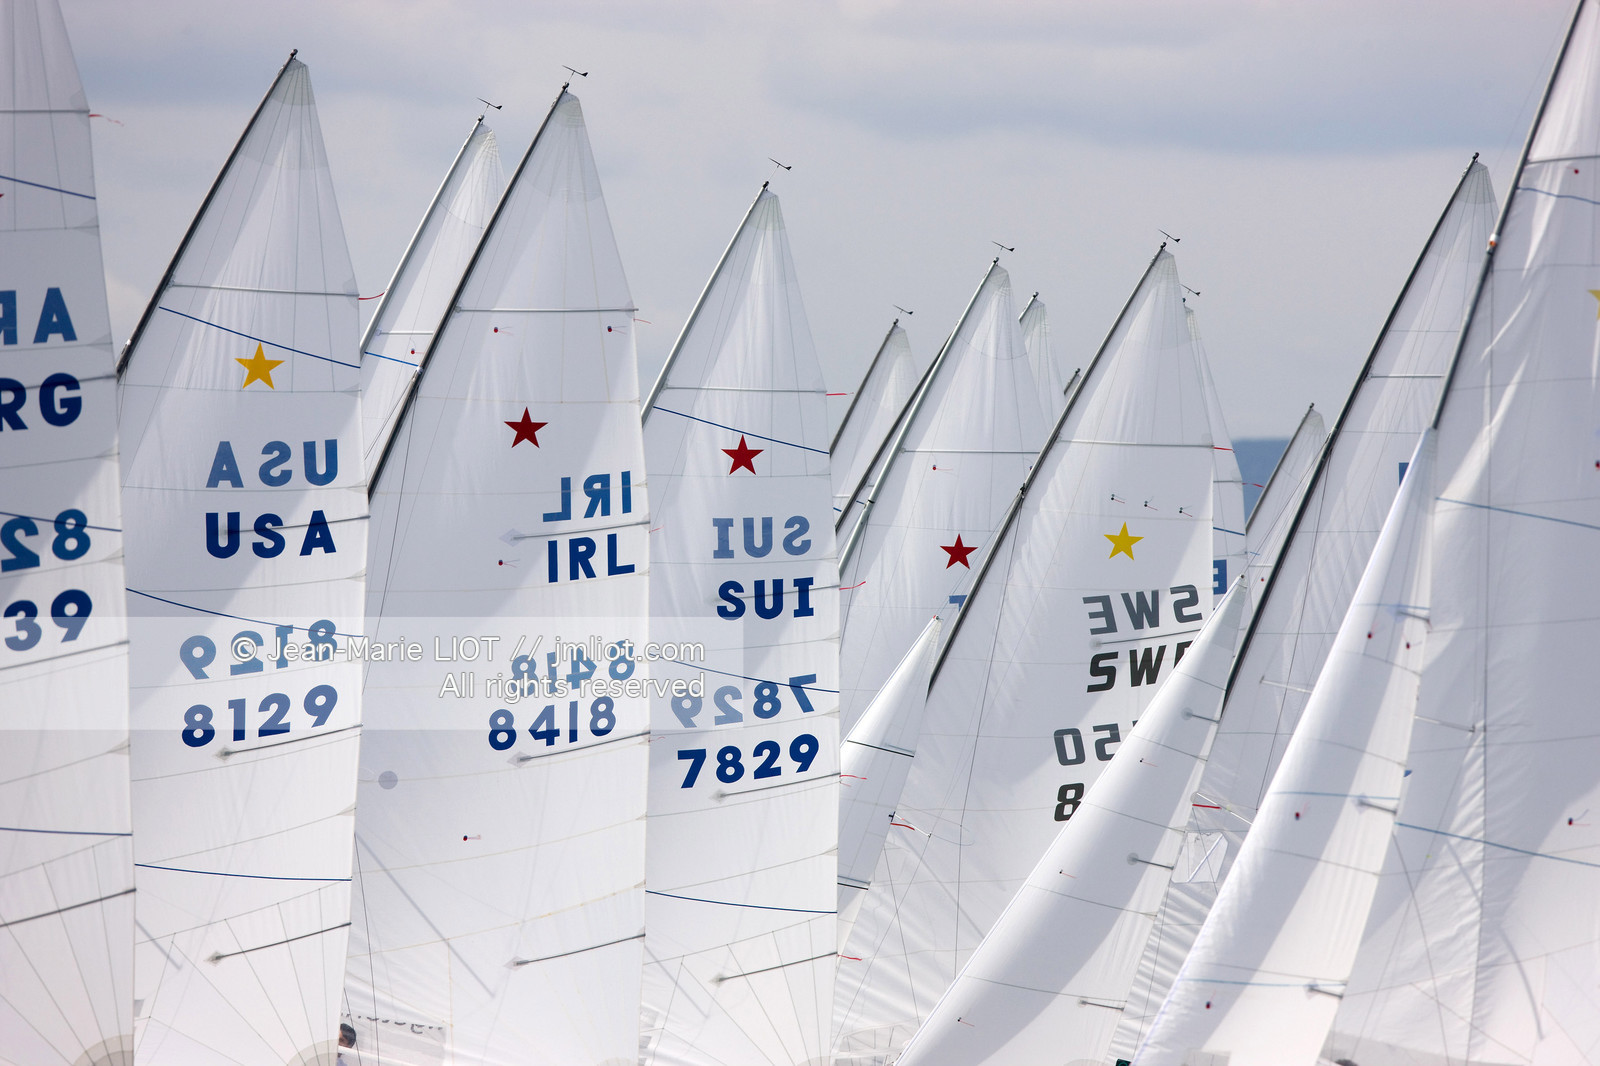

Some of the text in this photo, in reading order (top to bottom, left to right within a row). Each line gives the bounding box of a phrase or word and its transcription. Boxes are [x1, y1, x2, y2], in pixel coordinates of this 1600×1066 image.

[205, 510, 337, 559] USA
[547, 533, 636, 583] IRL
[716, 577, 815, 621] SUI
[181, 684, 338, 749] 8129
[488, 695, 617, 751] 8418
[677, 733, 820, 789] 7829
